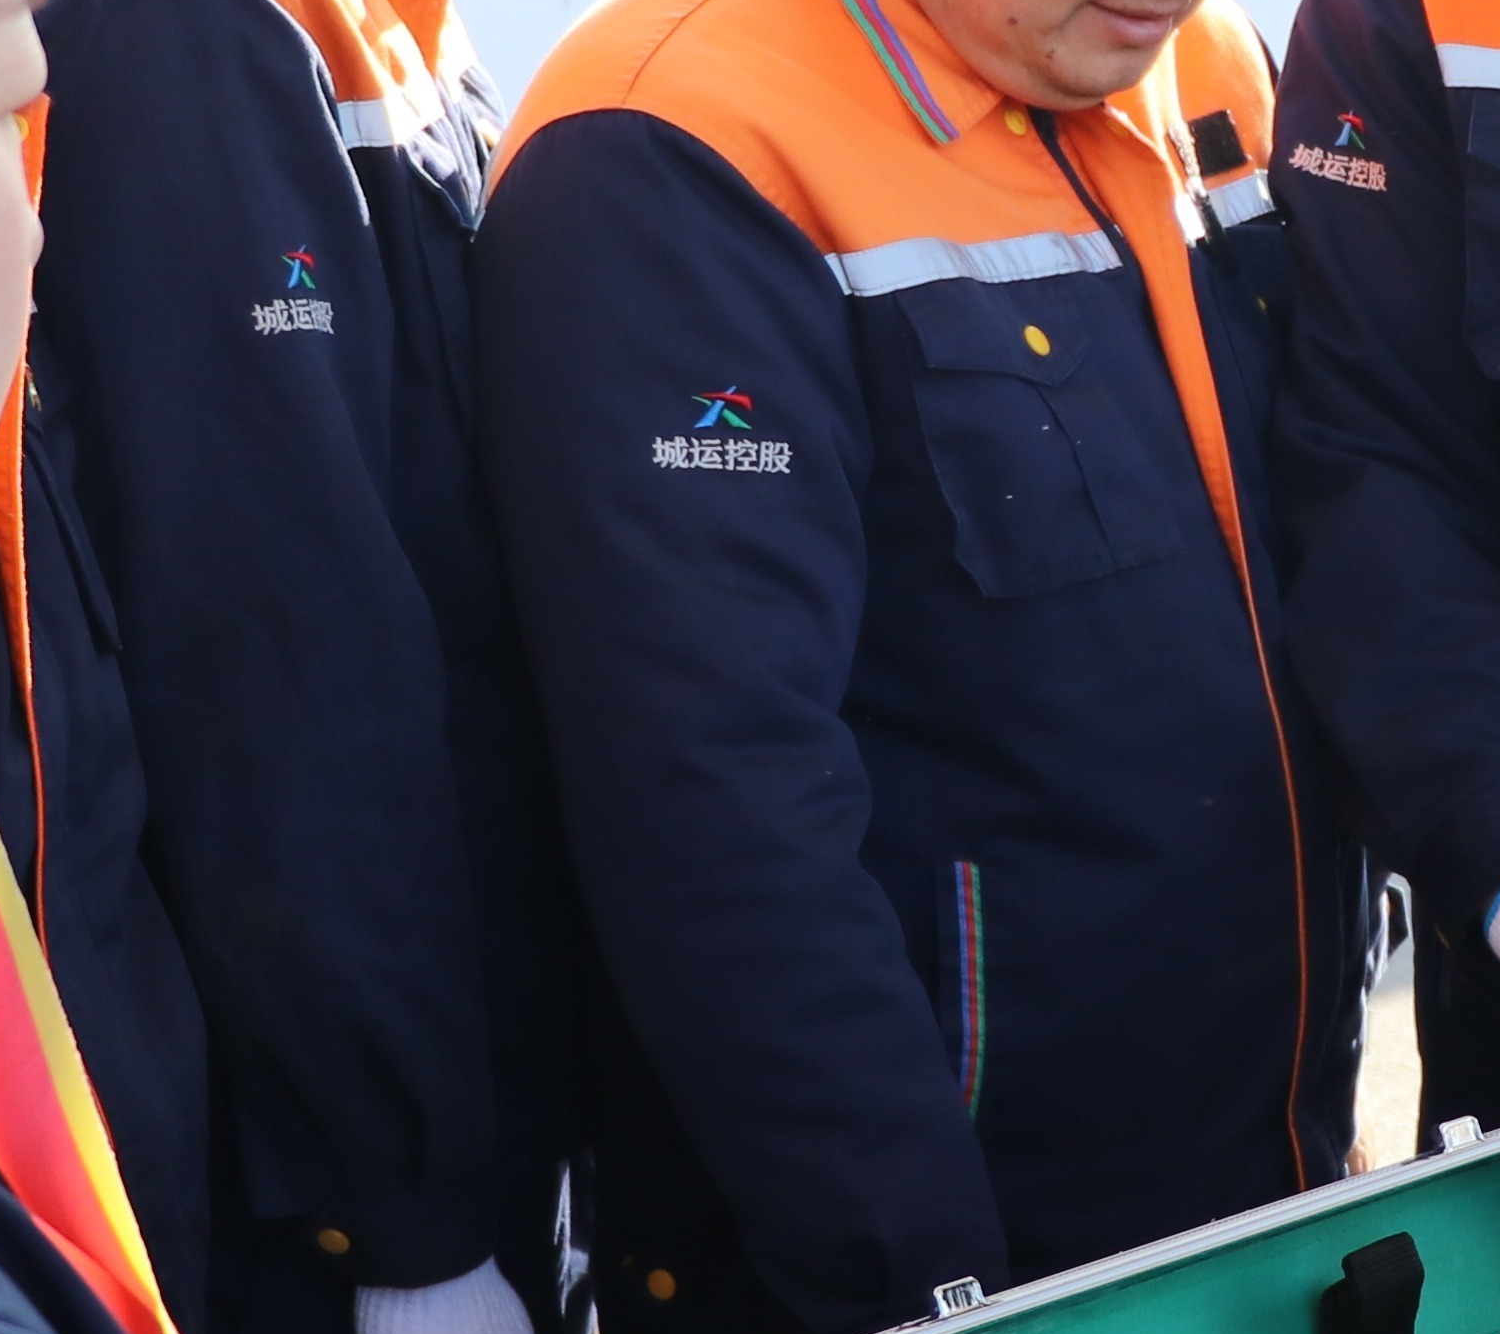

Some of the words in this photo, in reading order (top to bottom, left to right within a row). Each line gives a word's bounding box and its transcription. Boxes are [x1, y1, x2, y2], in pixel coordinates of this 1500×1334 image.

[1288, 143, 1388, 192] 城运控股
[651, 435, 793, 474] 城运控股
